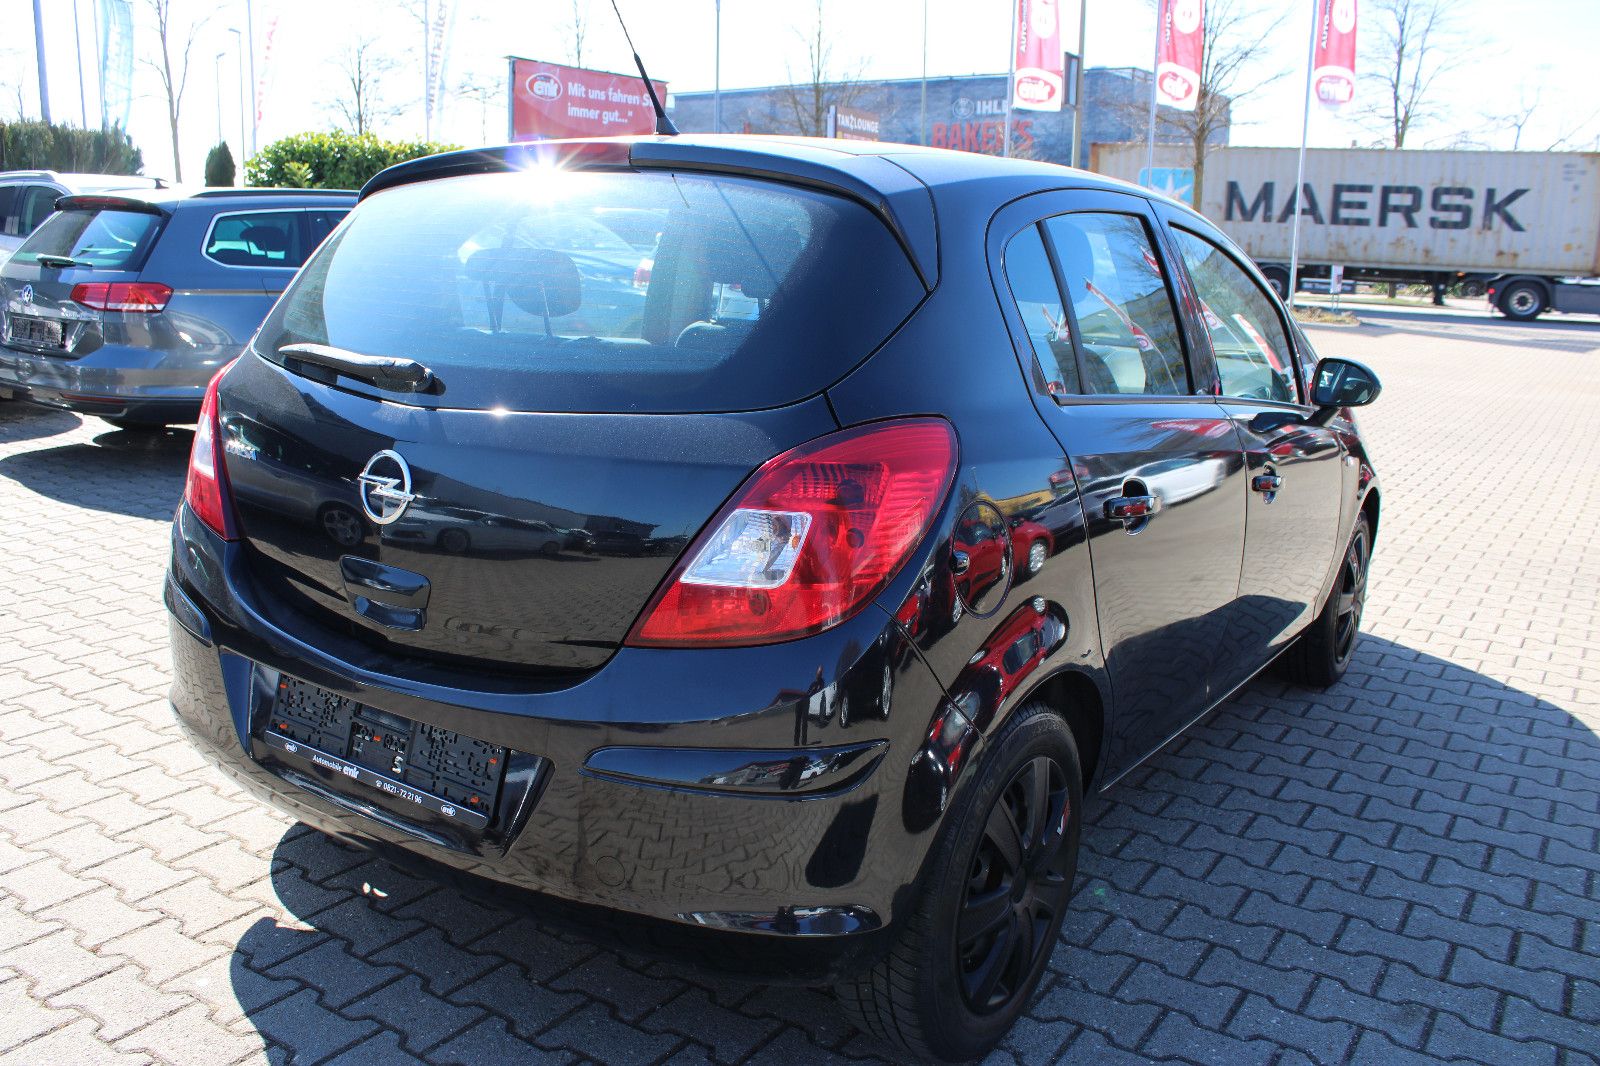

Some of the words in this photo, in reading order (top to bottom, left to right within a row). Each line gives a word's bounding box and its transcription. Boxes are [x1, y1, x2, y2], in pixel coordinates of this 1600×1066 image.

[567, 82, 585, 97] Mit
[588, 89, 605, 100] uns
[607, 88, 640, 105] fahren
[567, 102, 599, 119] immer
[1224, 180, 1531, 232] MAERSK
